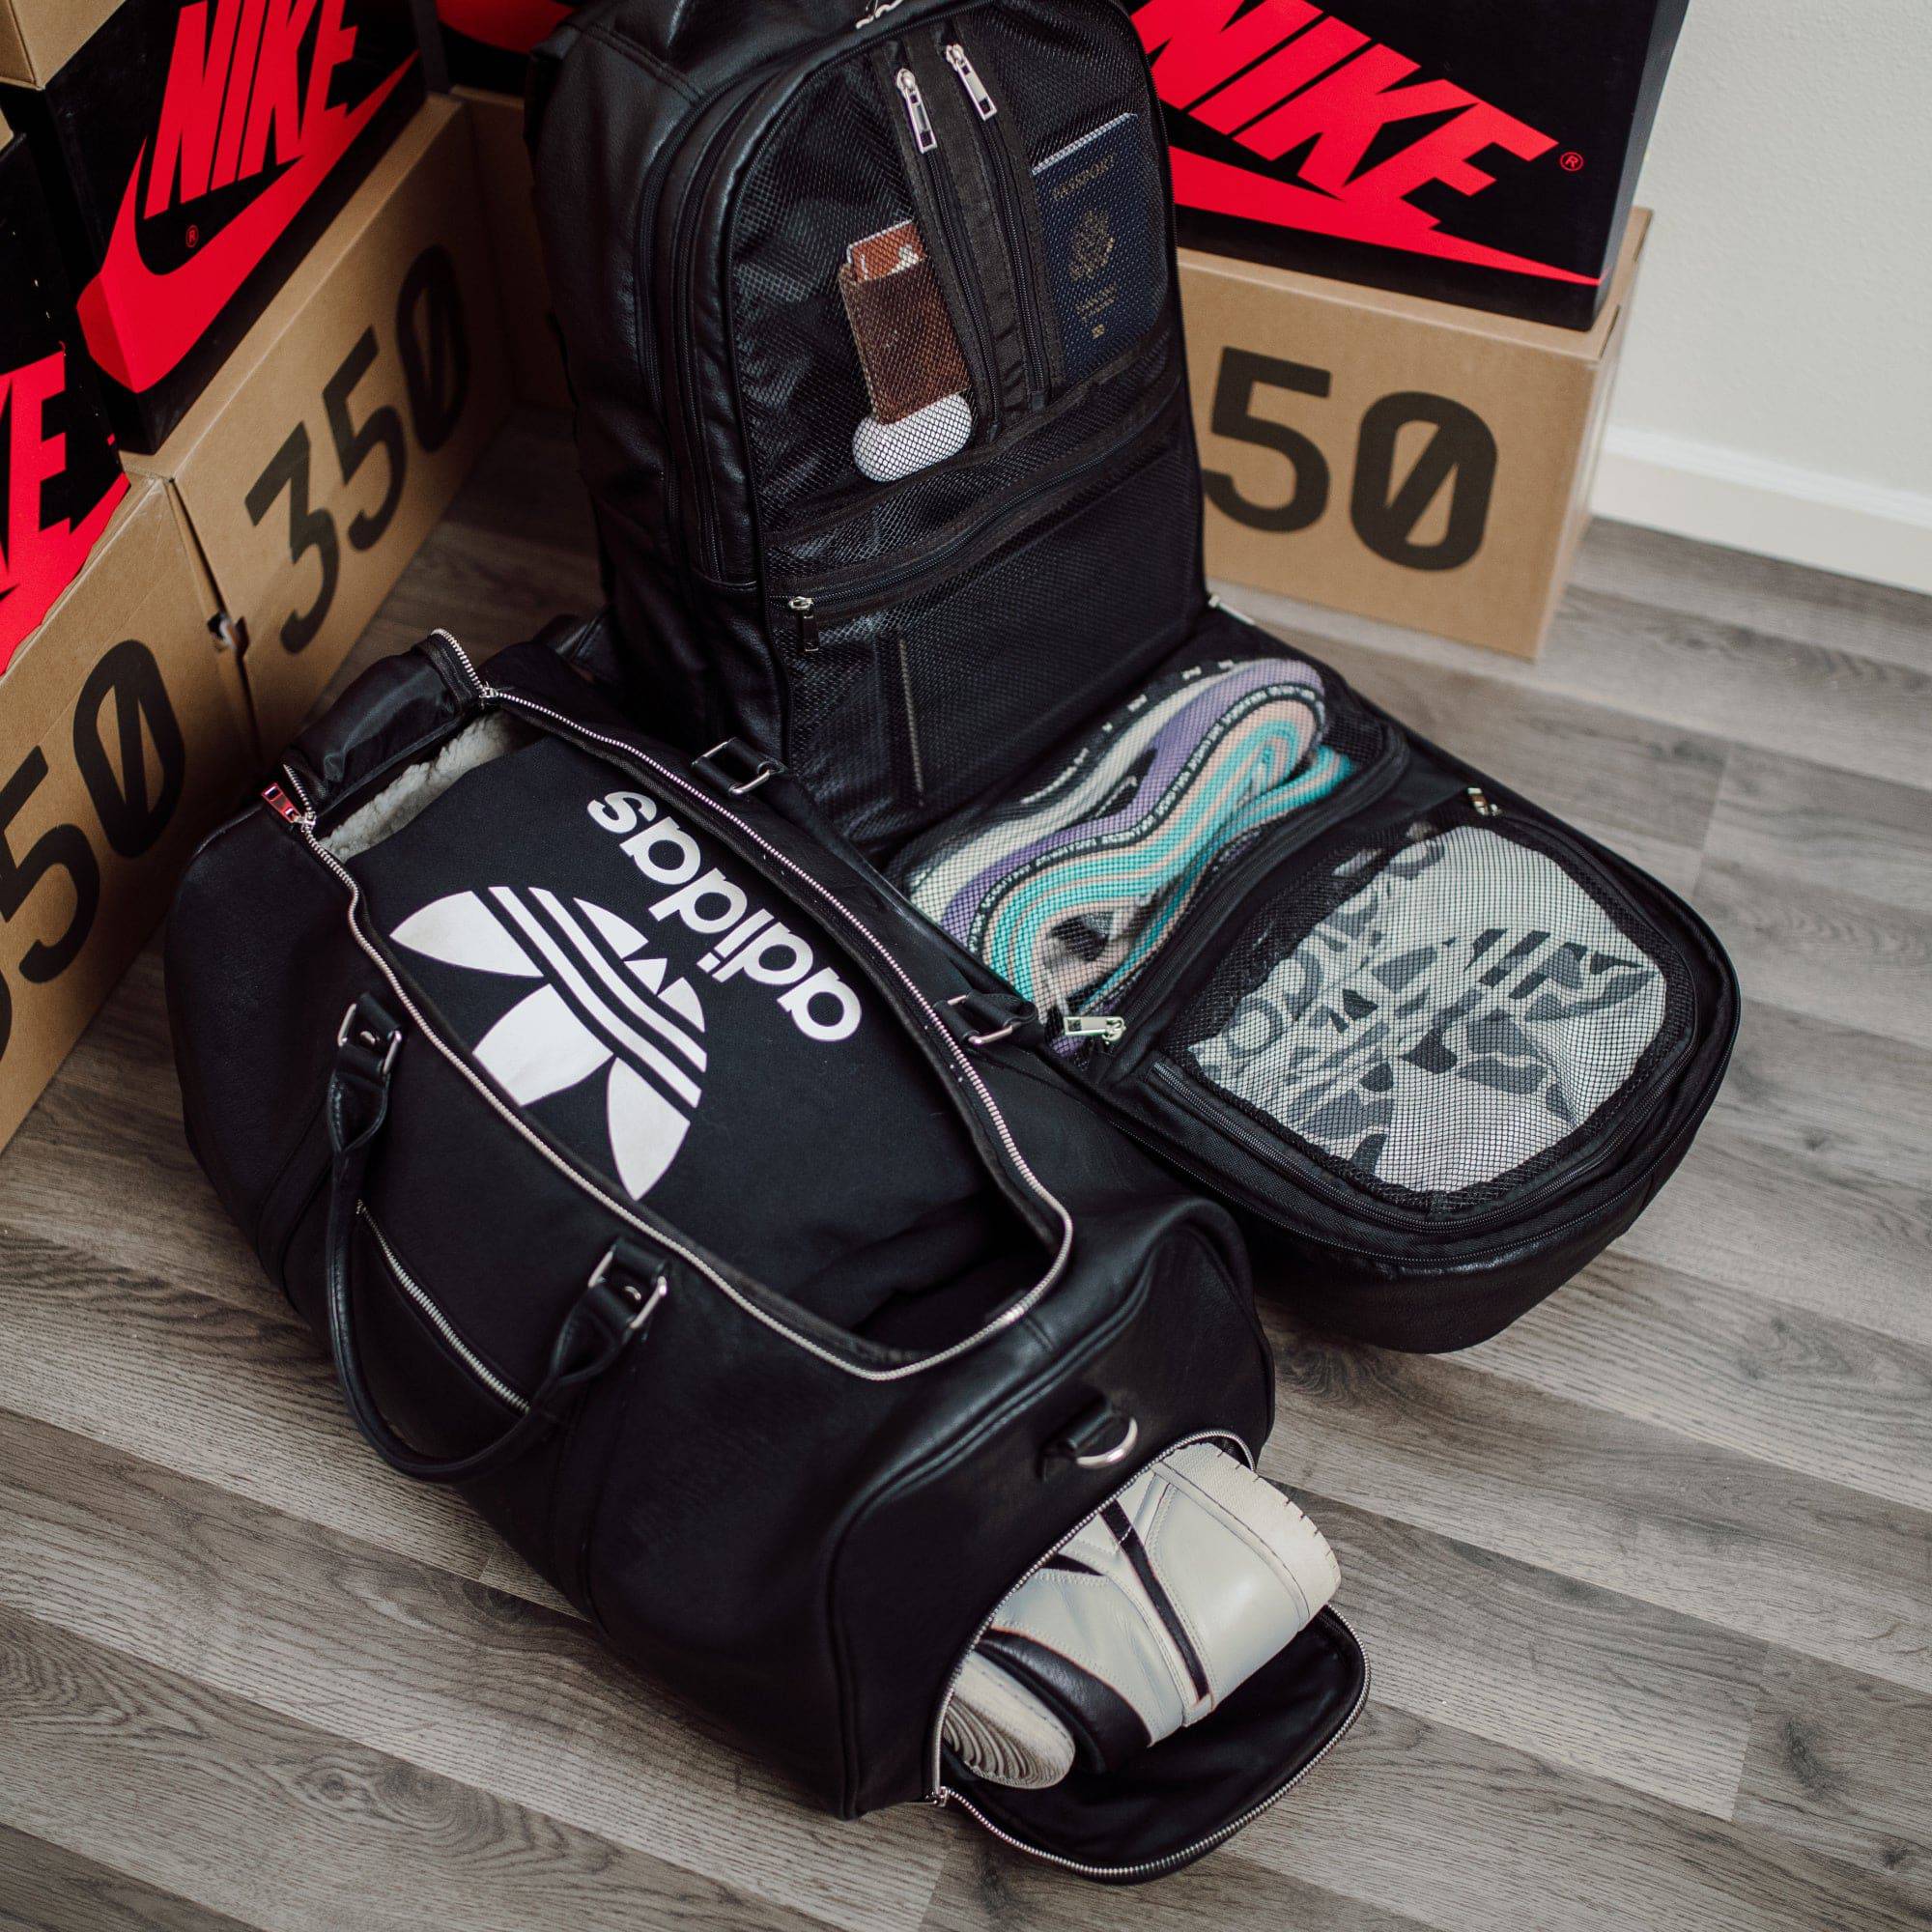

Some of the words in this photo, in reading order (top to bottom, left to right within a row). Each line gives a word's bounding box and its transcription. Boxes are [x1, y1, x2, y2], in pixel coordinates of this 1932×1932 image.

[144, 0, 358, 220] NIKE
[1128, 0, 1560, 230] NIKE
[244, 243, 470, 655] 350
[0, 639, 185, 1064] 50
[587, 791, 863, 1042] adidas
